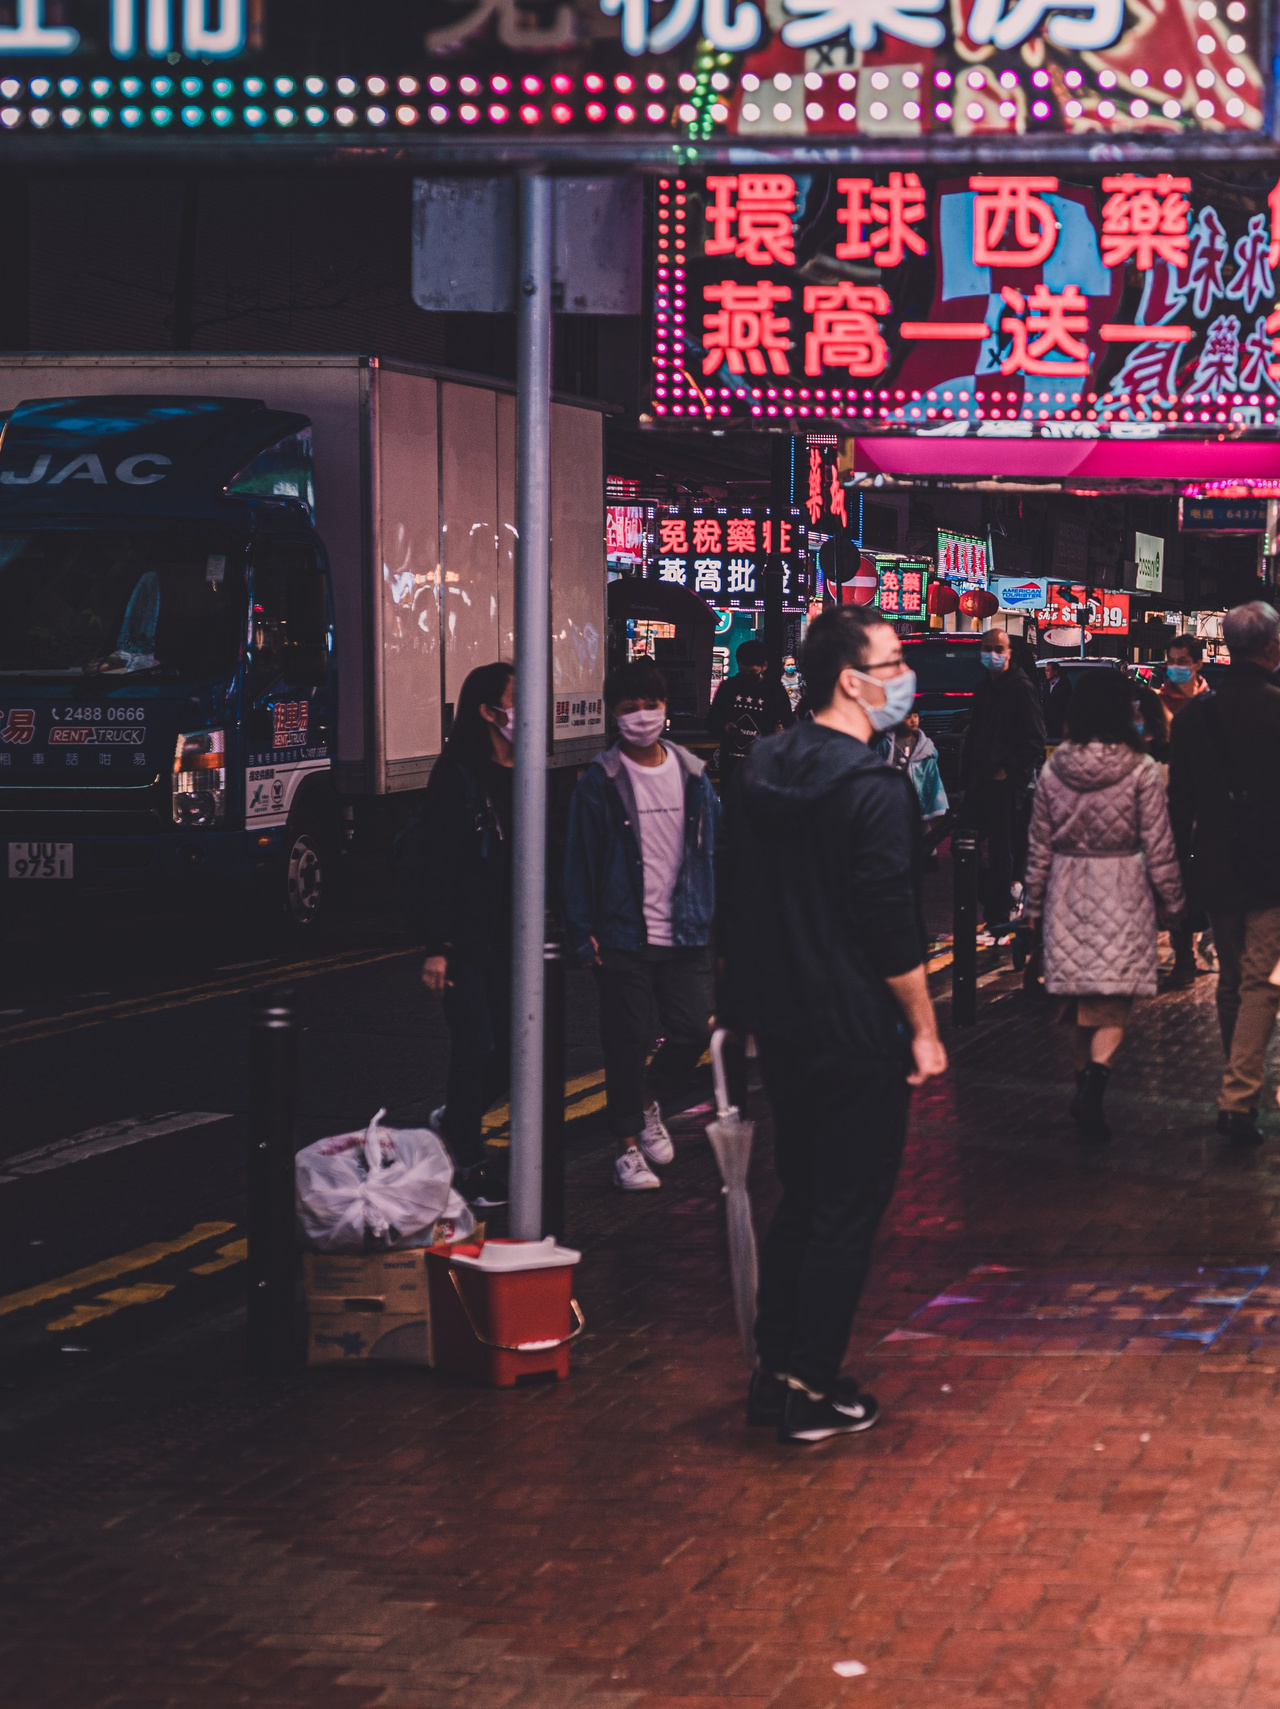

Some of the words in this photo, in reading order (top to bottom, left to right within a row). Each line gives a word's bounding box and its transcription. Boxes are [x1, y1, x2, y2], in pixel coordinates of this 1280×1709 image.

[704, 172, 1191, 270] 環球西藥
[702, 280, 1192, 378] 燕窩一送一
[1, 453, 173, 486] JAC
[0, 708, 35, 745] 易
[64, 707, 102, 721] 2488
[107, 707, 145, 721] 0666
[53, 729, 89, 742] RENT
[97, 729, 141, 742] TRUCK
[27, 842, 57, 860] UU
[14, 859, 67, 877] 9751
